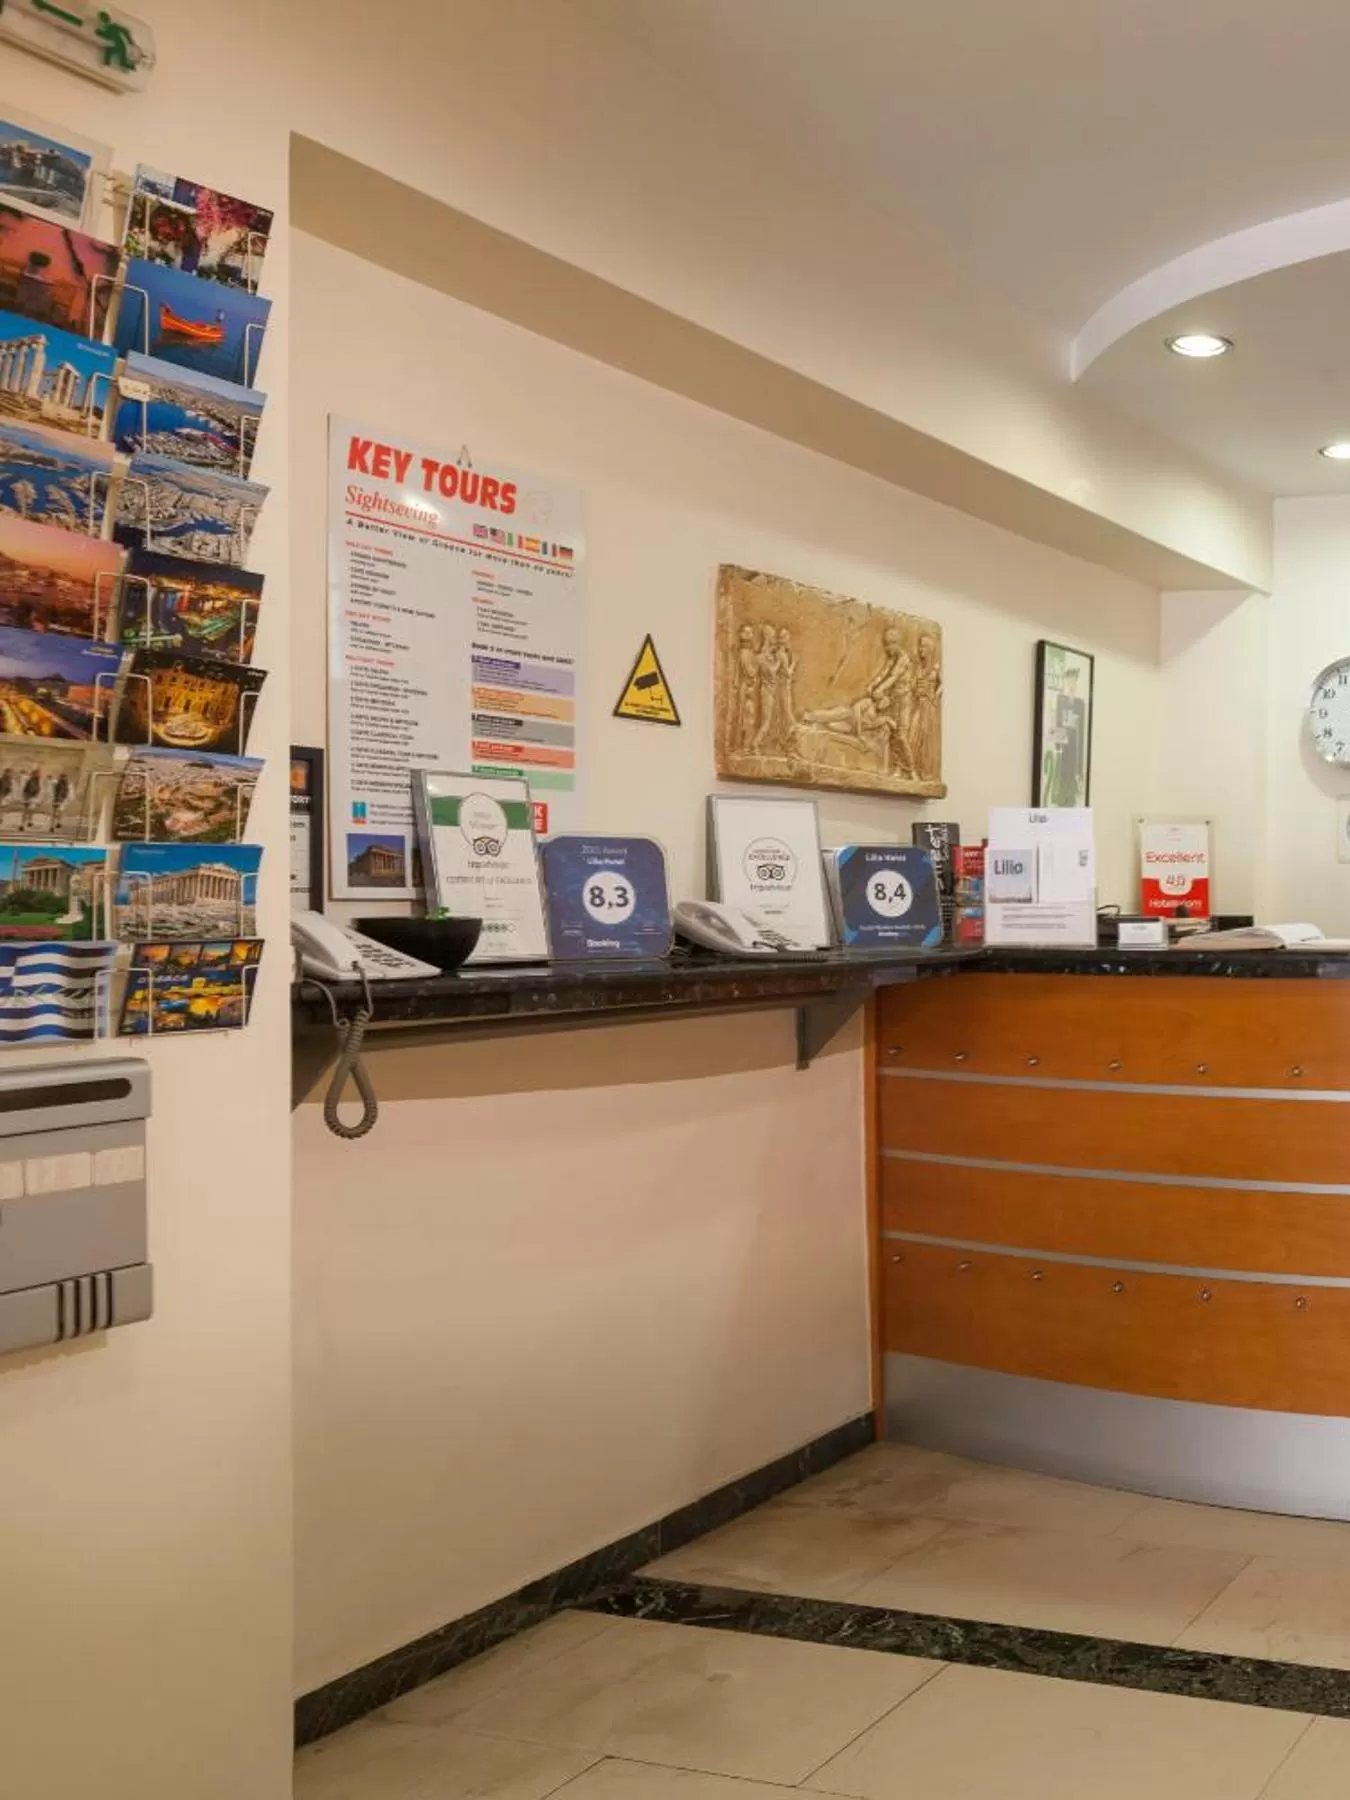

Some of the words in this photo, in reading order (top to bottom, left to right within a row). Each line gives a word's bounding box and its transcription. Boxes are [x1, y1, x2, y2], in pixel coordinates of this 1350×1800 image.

[347, 436, 413, 484] KEY
[421, 457, 517, 515] TOURS
[345, 484, 438, 529] Sightseeing
[431, 539, 466, 554] Greece
[1323, 688, 1335, 700] 10
[1318, 708, 1327, 720] 9
[1323, 728, 1333, 739] 8
[1335, 741, 1345, 754] 7
[1145, 850, 1206, 864] Excellent
[588, 885, 630, 909] 8,3
[874, 882, 907, 904] 8,4
